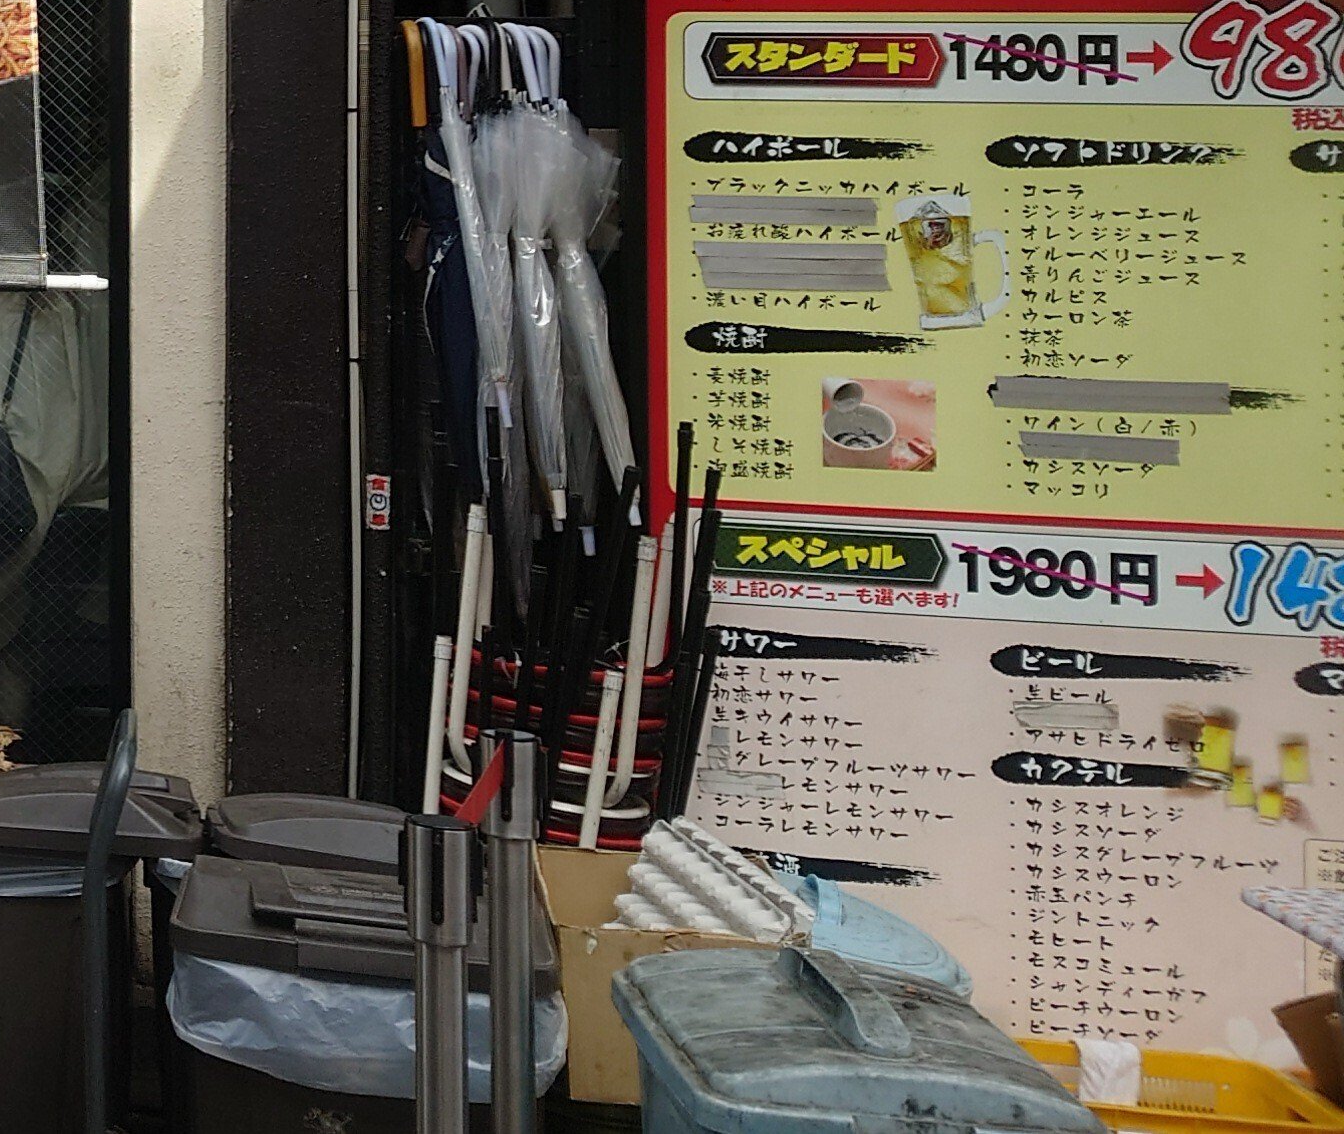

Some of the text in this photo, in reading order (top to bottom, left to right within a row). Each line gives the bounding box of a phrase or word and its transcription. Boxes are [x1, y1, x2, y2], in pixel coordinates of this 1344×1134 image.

[723, 39, 918, 77] スタンダード
[712, 136, 850, 159] ハイボール
[1014, 141, 1212, 165] ソフトドリンク
[707, 176, 972, 197] ブラックニッカハイボール
[1022, 184, 1085, 199] コーラ
[1022, 205, 1201, 224] ジンジャーエール
[1021, 226, 1201, 244] オレンジジュース
[1021, 247, 1247, 266] ブルーベリージュース
[1021, 267, 1201, 287] 青りんごジュース
[707, 291, 881, 312] 濃い目ハイボール
[1021, 289, 1108, 306] カルピス
[1021, 310, 1133, 328] ウーロン茶
[712, 326, 768, 351] 焼酎
[1020, 329, 1064, 347] 抹茶
[1020, 352, 1134, 369] 初恋ソーダ
[707, 367, 771, 386] 麦焼酎
[707, 391, 771, 409] 芋焼酎
[707, 413, 772, 432] 米焼酎
[711, 437, 794, 458] しそ焼酎
[1024, 481, 1111, 499] マッコリ
[735, 535, 907, 573] スペシャル
[720, 629, 798, 654] サワー
[1021, 651, 1104, 674] ビール
[710, 684, 818, 703] 初恋サワー
[1025, 684, 1113, 704] 生ビール
[711, 706, 863, 727] 生キウイサワー
[736, 730, 863, 749] レモンサワー
[1025, 730, 1206, 753] アサヒドライゼロ
[736, 752, 977, 779] グレープフルーツサワー
[1021, 758, 1134, 783] カクテル
[781, 775, 909, 796] レモンサワー
[714, 795, 955, 821] ジンジャーレモンサワー
[1027, 797, 1184, 820] カシスオレンジ
[715, 815, 910, 839] コーラレモンサワー
[1027, 819, 1162, 841] カシスソーダ
[1027, 842, 1279, 873] カシスグレープフルーツ
[1027, 865, 1182, 888] カシスウーロン
[1026, 887, 1138, 906] 赤玉パンチ
[1028, 909, 1160, 931] ジントニック
[1028, 931, 1114, 950] モヒート
[1028, 954, 1185, 980] モスコミュール
[1029, 976, 1208, 1002] シャンディーガフ
[1029, 999, 1184, 1023] ピーチウーロン
[1029, 1022, 1163, 1044] ピーチソーダ
